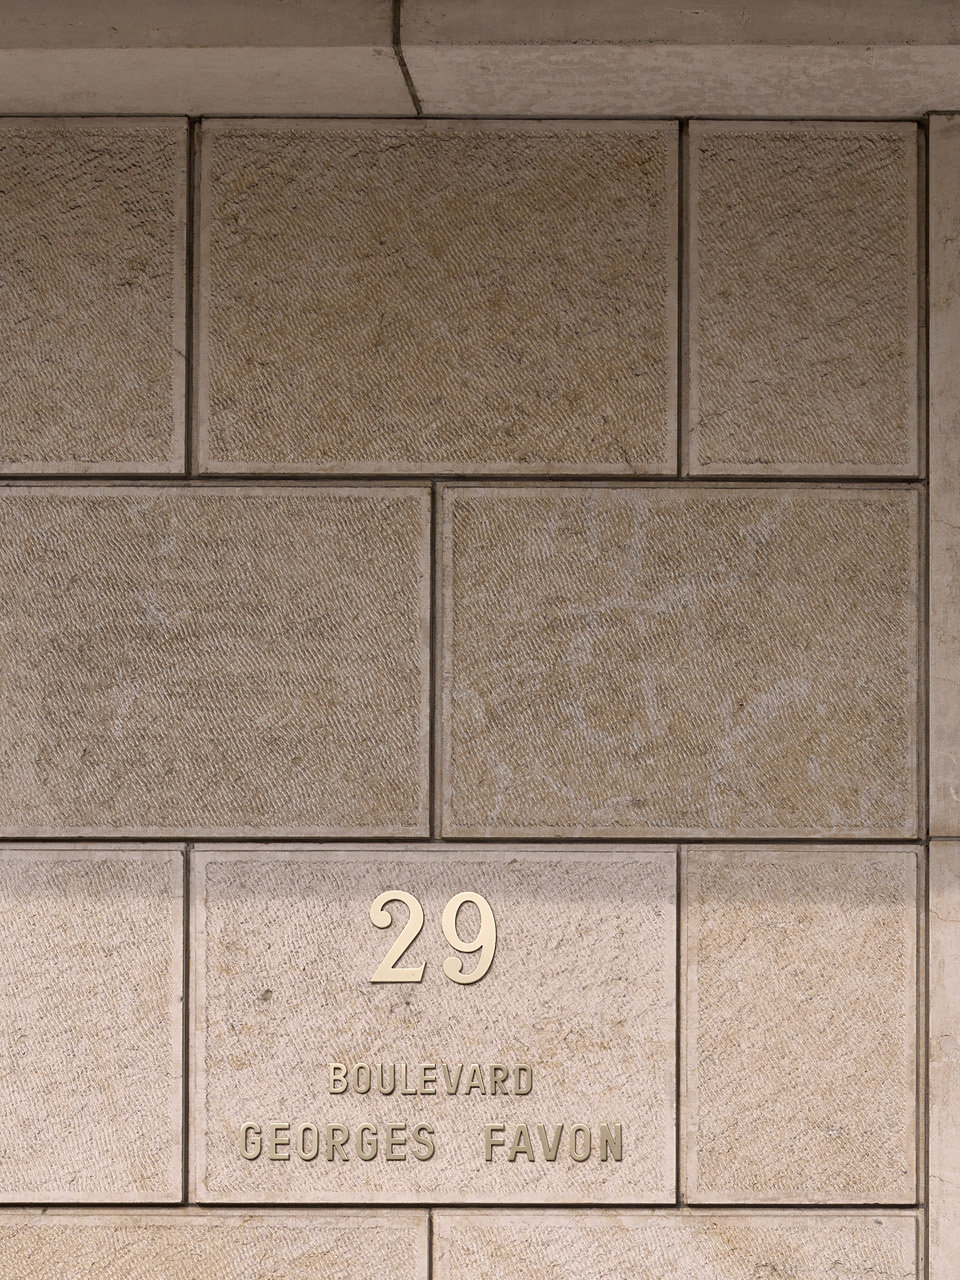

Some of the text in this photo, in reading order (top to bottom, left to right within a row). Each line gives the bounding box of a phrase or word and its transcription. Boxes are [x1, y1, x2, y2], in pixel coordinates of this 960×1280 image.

[369, 889, 497, 985] 29
[328, 1063, 533, 1096] BOULEVARD
[239, 1121, 623, 1162] GEORGES FAVON
